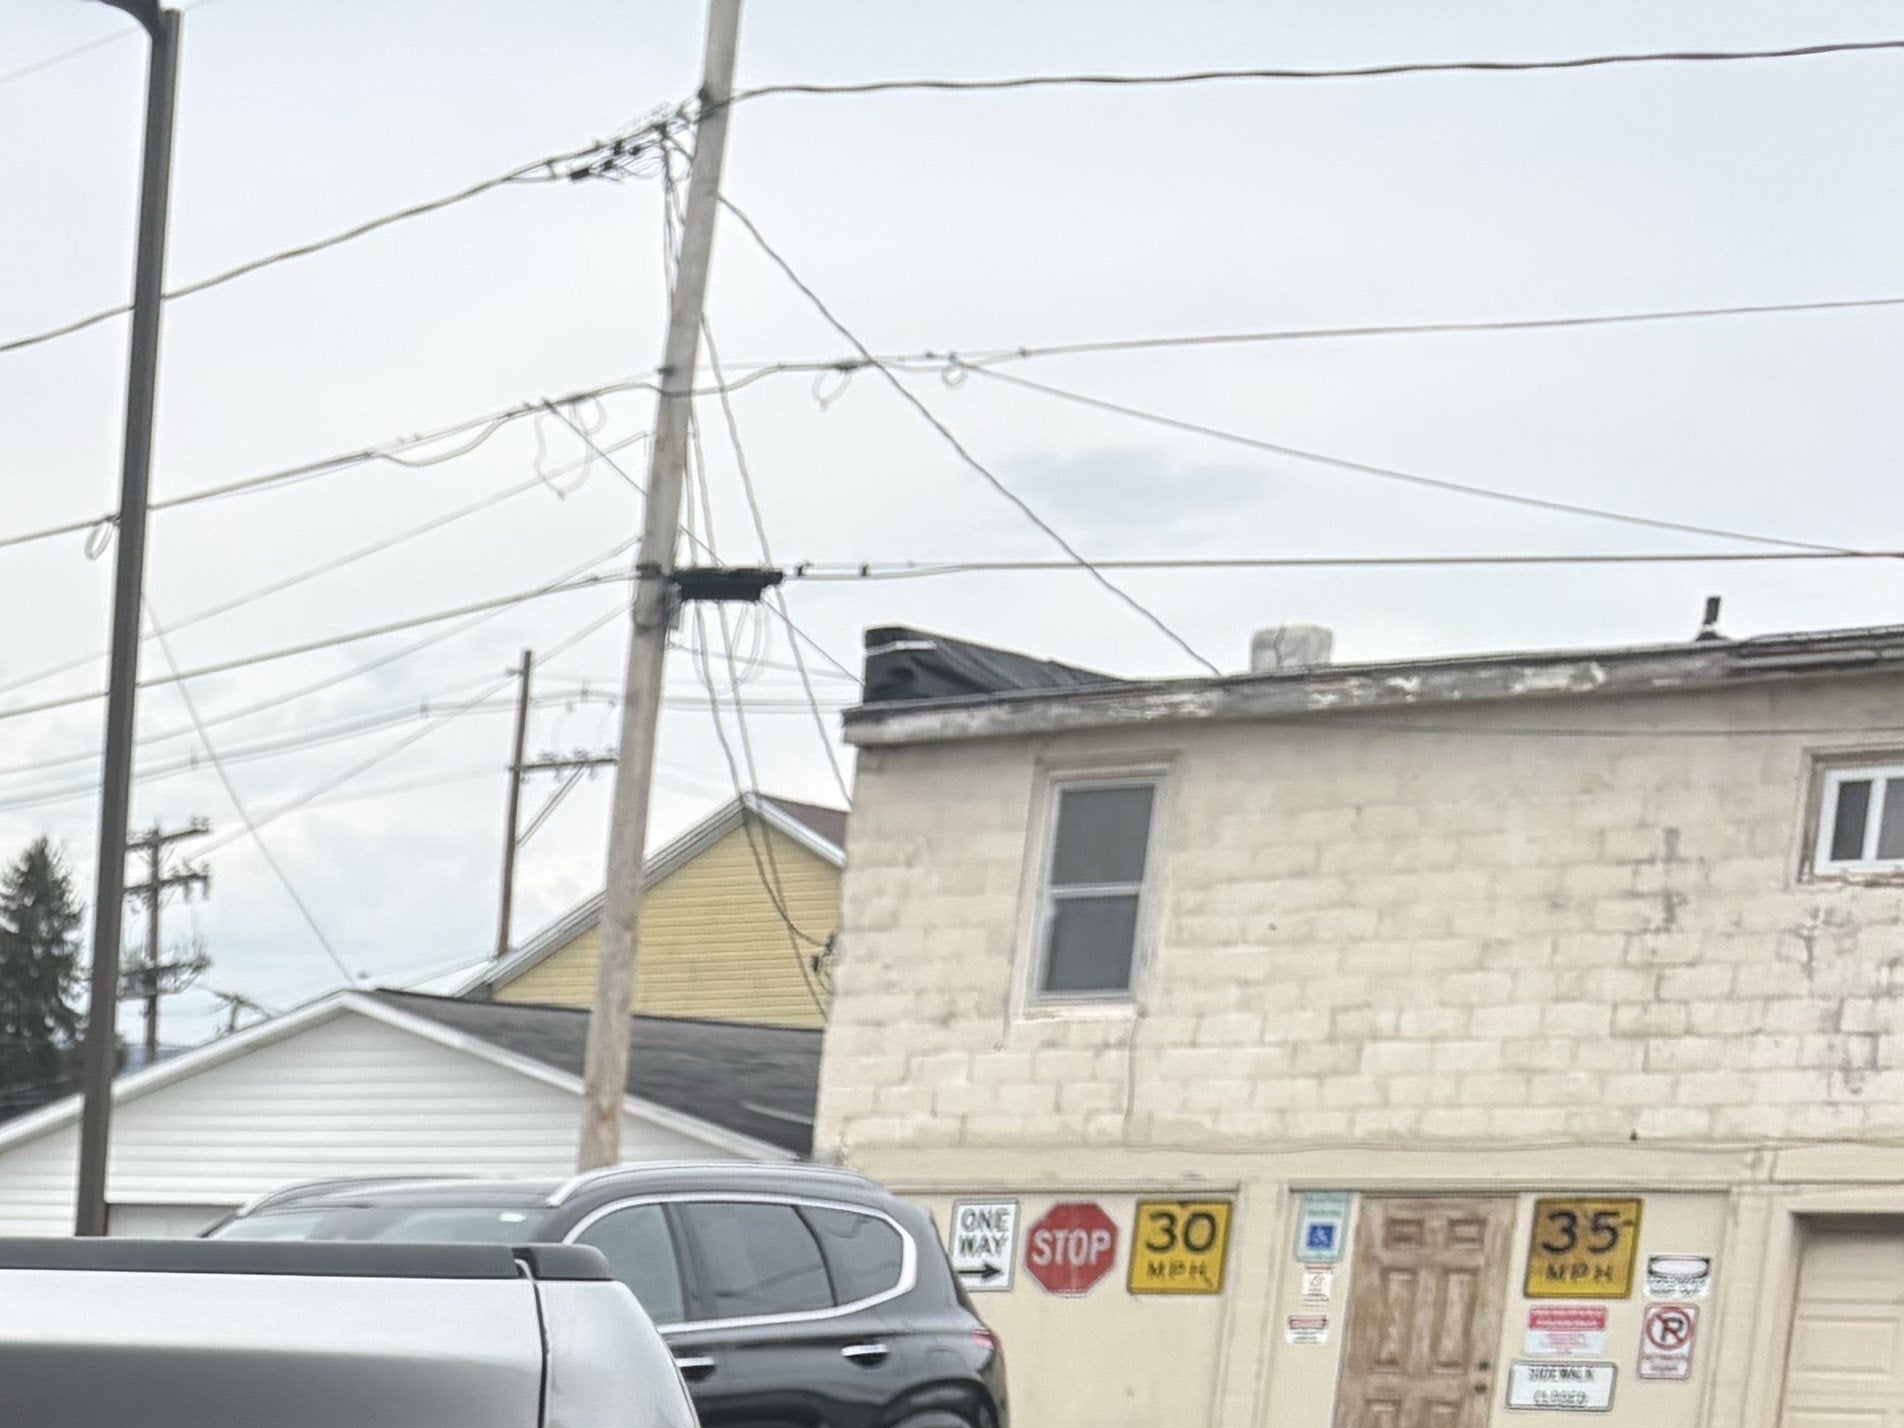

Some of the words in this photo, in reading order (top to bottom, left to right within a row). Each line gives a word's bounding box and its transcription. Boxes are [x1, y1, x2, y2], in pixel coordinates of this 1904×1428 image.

[960, 1207, 1009, 1232] ONE
[1145, 1210, 1219, 1254] 30
[1541, 1209, 1622, 1255] 35
[959, 1232, 1009, 1257] WAY
[1031, 1229, 1112, 1267] STOP
[1146, 1262, 1209, 1281] MPH
[1545, 1263, 1615, 1283] MPH
